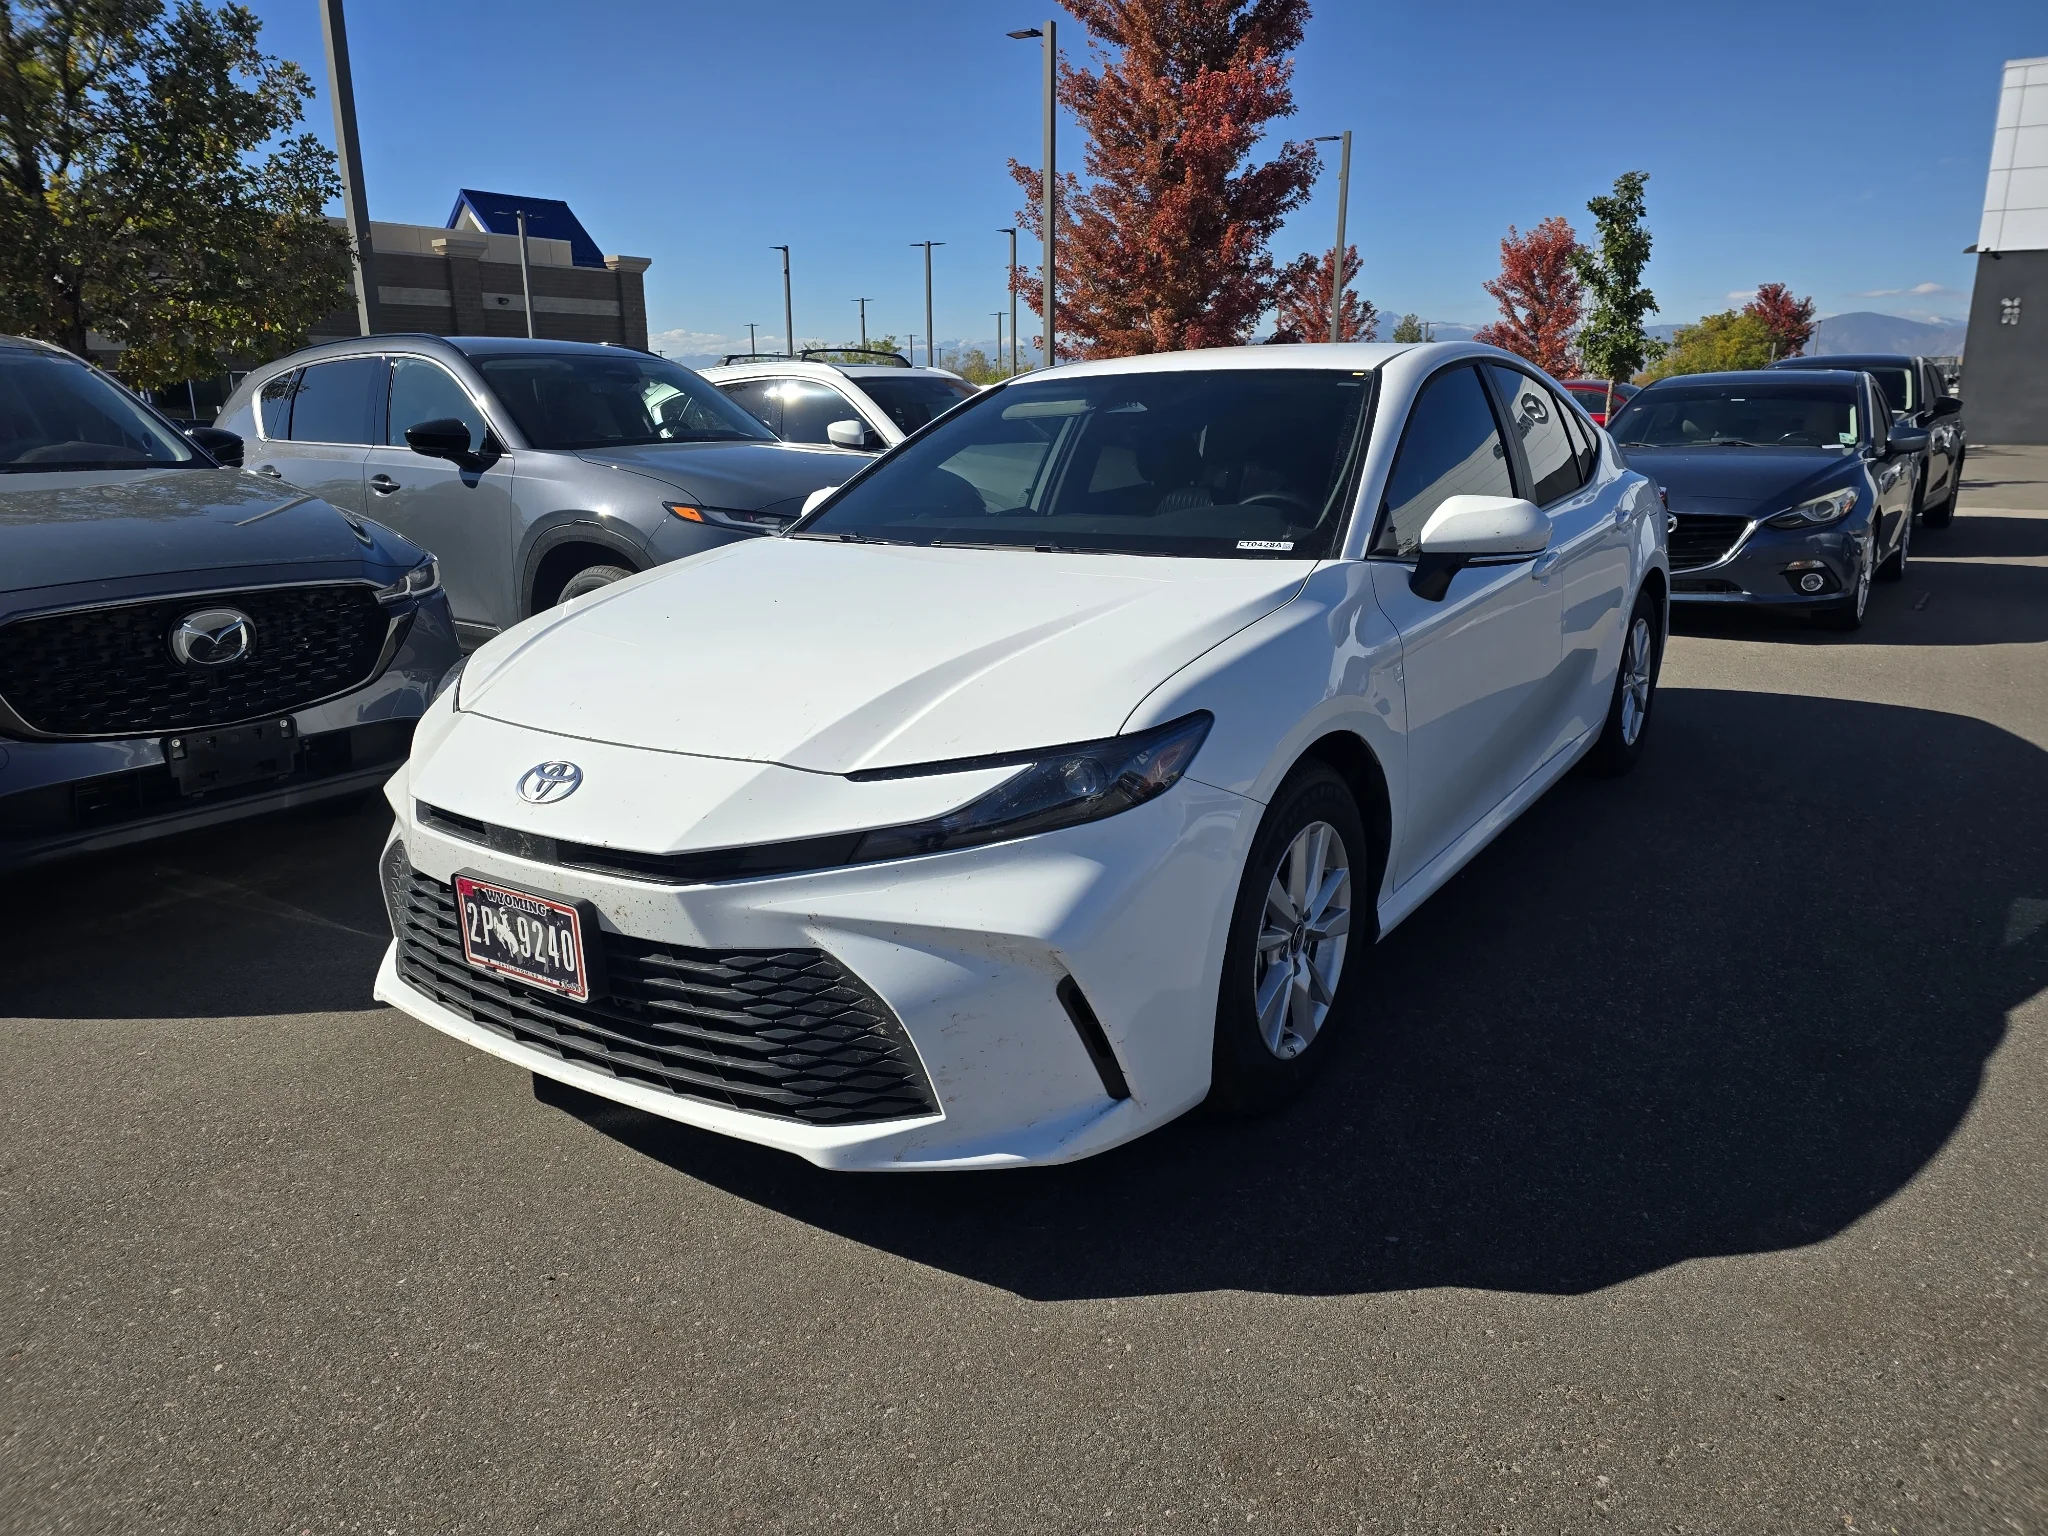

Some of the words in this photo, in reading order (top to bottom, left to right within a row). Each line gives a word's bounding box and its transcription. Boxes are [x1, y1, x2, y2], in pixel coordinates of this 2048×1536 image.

[485, 889, 547, 916] WYOMING
[467, 902, 493, 946] 2P
[516, 916, 575, 972] 9240
